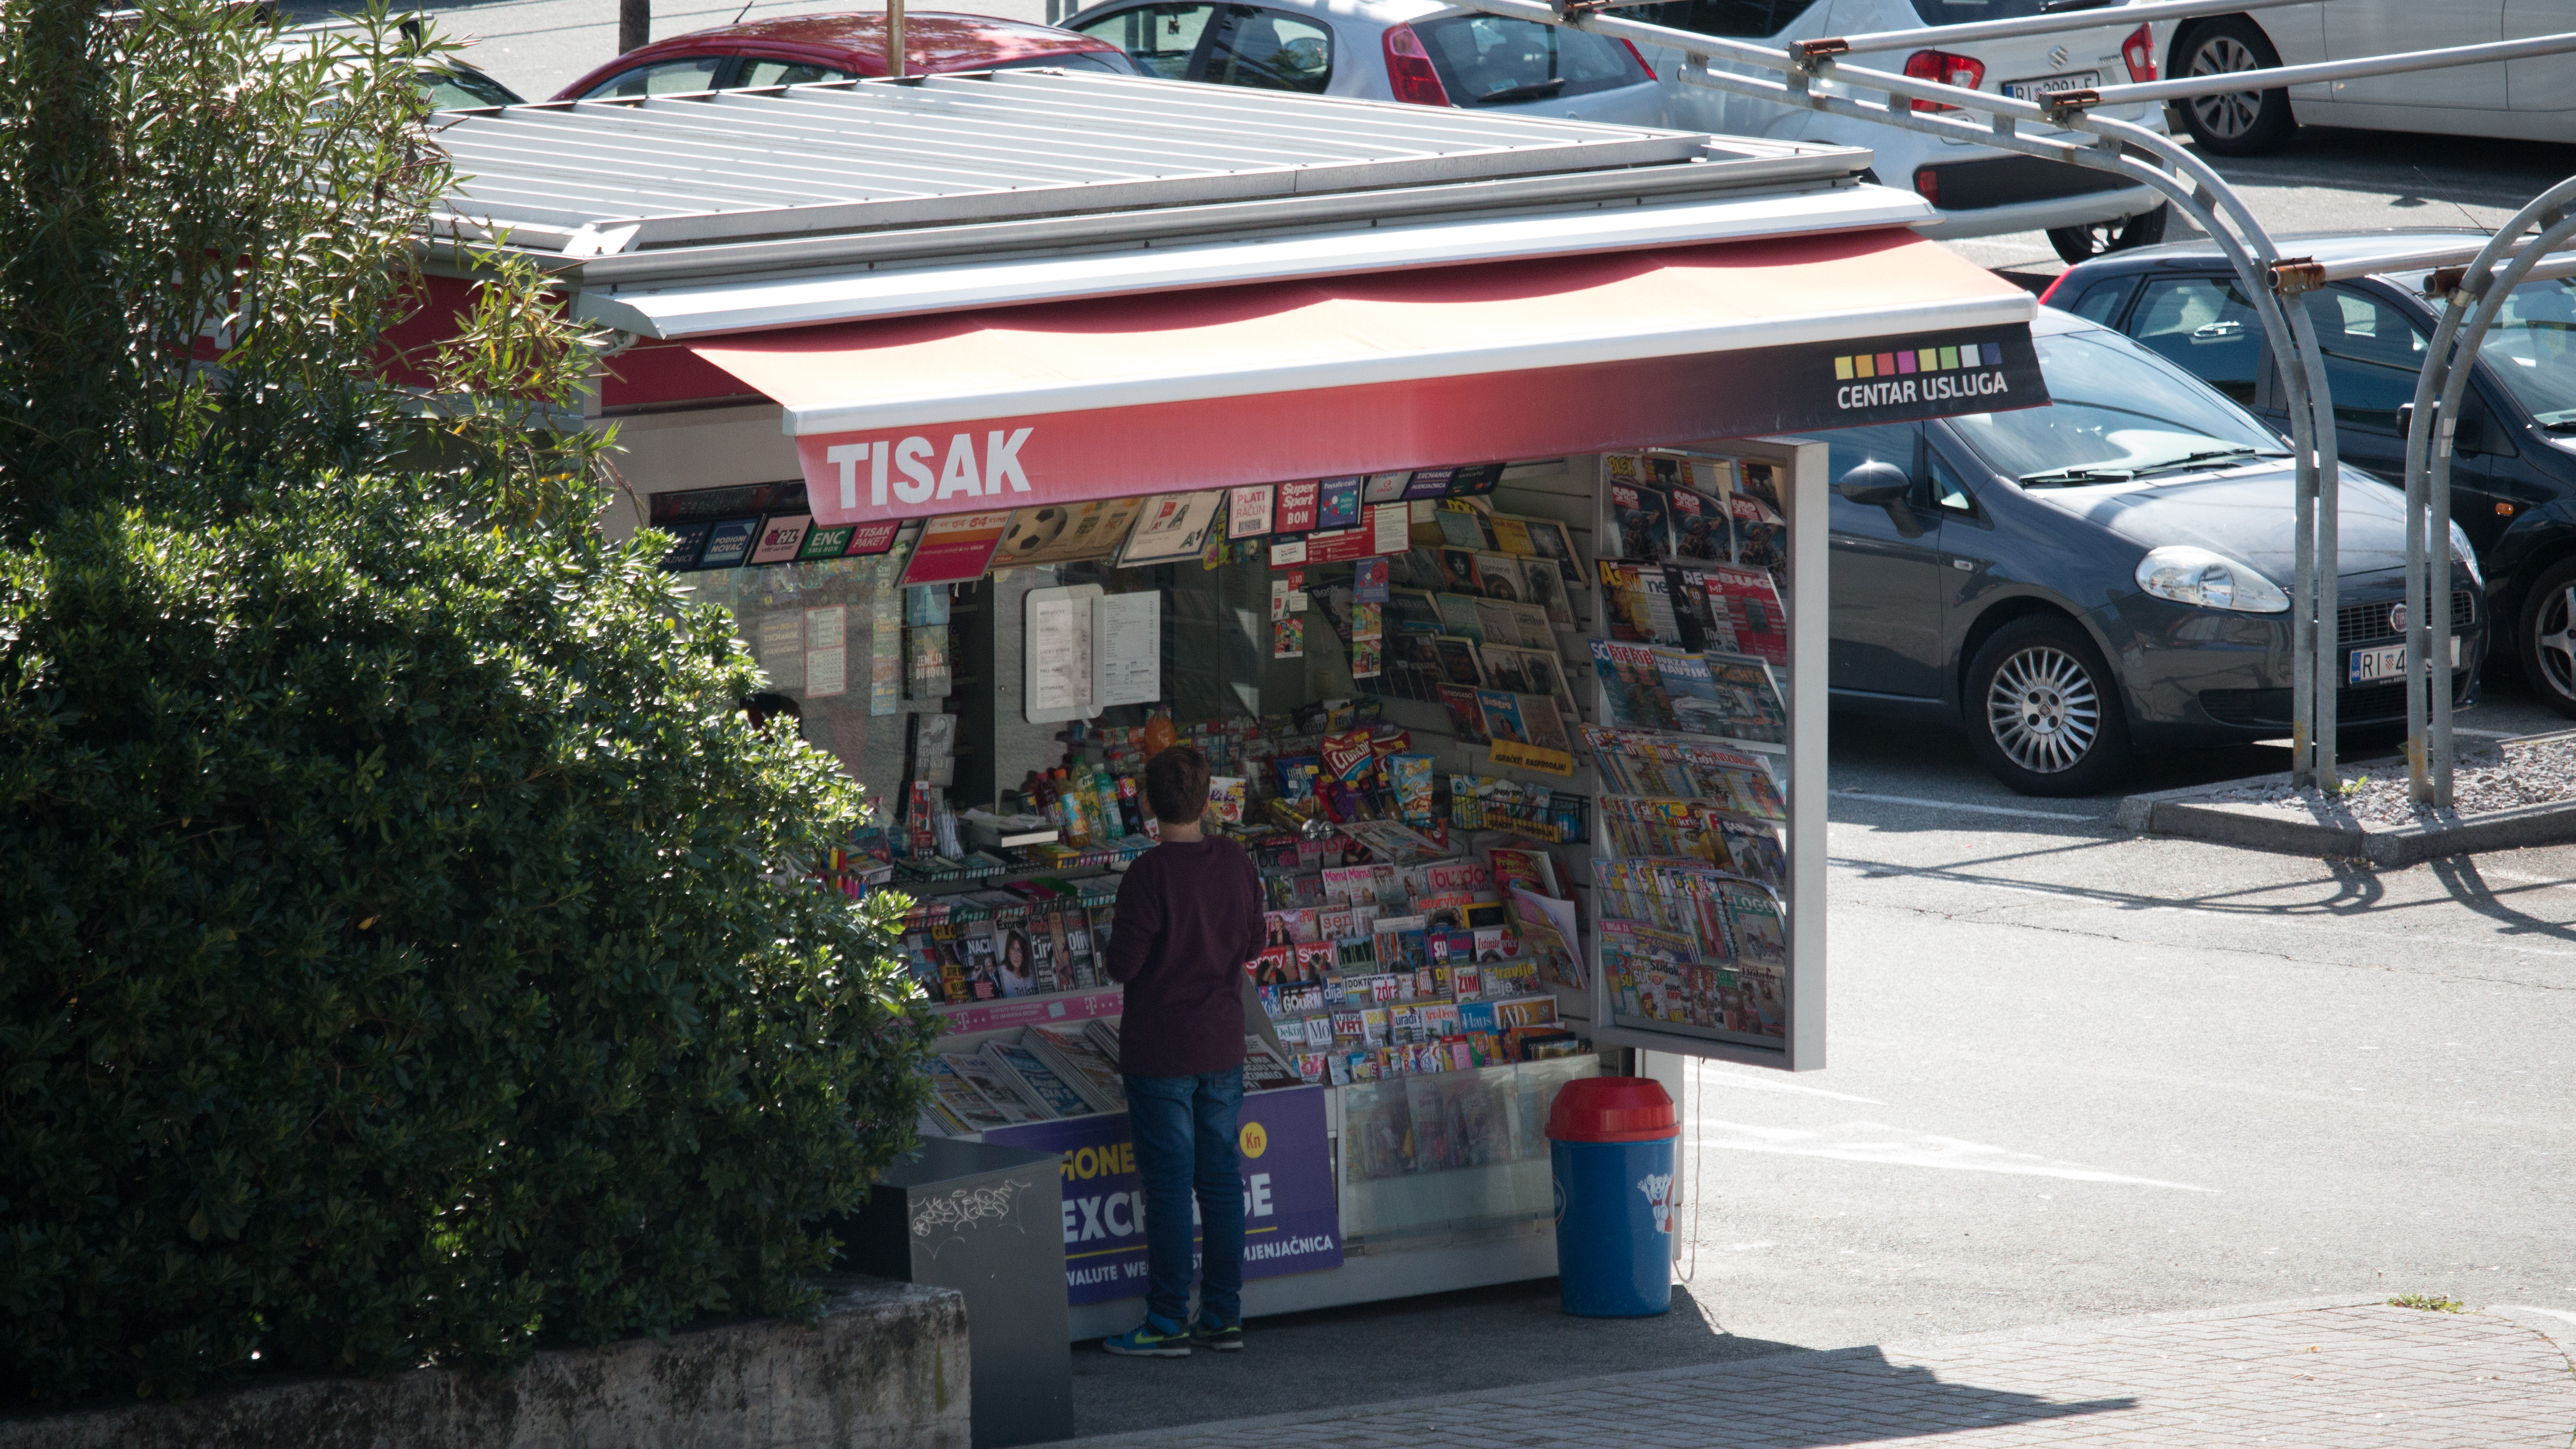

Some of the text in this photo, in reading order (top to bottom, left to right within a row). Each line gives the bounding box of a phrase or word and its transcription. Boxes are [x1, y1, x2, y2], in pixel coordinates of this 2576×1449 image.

[1838, 371, 2008, 409] CENTAR USLUGA
[827, 427, 1034, 509] TISAK
[1417, 471, 1452, 480] EXCHANGE
[1282, 482, 1317, 497] Super
[1237, 491, 1265, 505] PLATI
[1282, 494, 1314, 509] Sport
[1236, 503, 1265, 518] RAČUN
[1287, 510, 1309, 524] BON
[811, 530, 846, 547] ENC
[859, 525, 894, 537] TISAK
[715, 534, 747, 544] PODIGNI
[853, 536, 887, 548] PAKET
[711, 542, 743, 553] NOVAC
[1720, 572, 1772, 588] BUG
[917, 652, 943, 667] ZEMLJA
[2363, 652, 2380, 677] RI
[916, 666, 946, 680] DUHOVA
[2351, 669, 2360, 678] HR
[1324, 870, 1347, 882] Mama
[1347, 868, 1371, 880] Mama
[1433, 864, 1487, 888] burda
[1419, 892, 1474, 911] storybook
[1298, 947, 1333, 966] Story
[1462, 1012, 1492, 1030] Haus
[1503, 1005, 1529, 1028] AD
[1245, 1132, 1261, 1150] Kn
[1066, 1264, 1118, 1287] VALUTE
